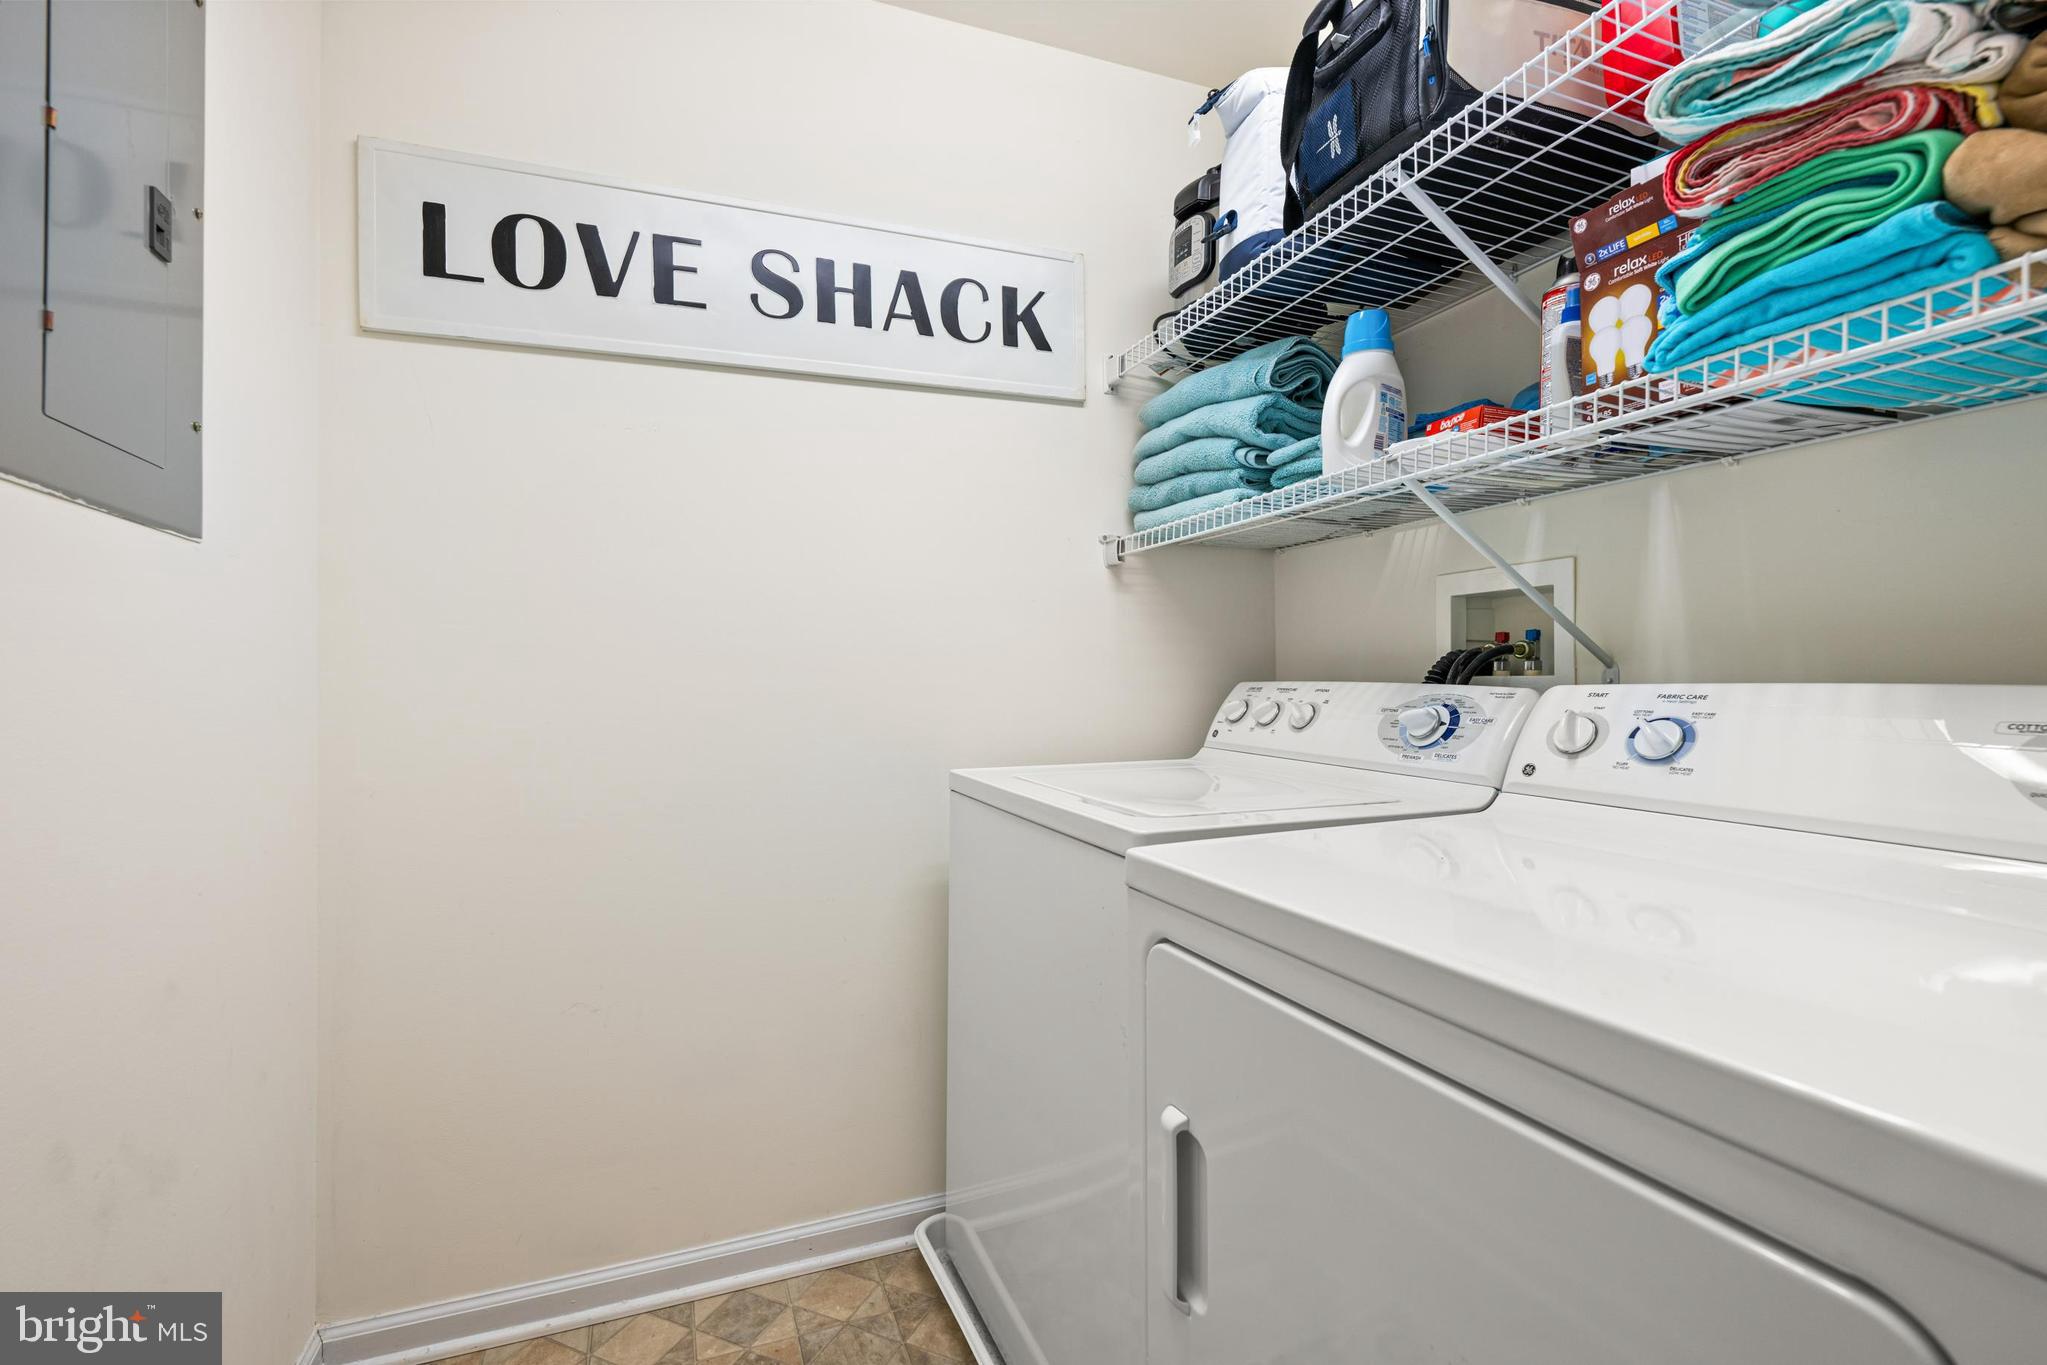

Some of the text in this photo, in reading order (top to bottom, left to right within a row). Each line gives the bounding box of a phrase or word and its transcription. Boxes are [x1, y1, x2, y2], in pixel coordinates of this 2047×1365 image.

[1608, 191, 1649, 216] relax LED
[1598, 239, 1627, 258] 2x LIFE
[421, 200, 1053, 353] LOVE SHACK
[1608, 270, 1634, 286] Comfortable
[1633, 266, 1644, 275] Soft
[1643, 261, 1658, 271] White
[1613, 250, 1664, 278] relax LED
[1439, 412, 1465, 431] bounce
